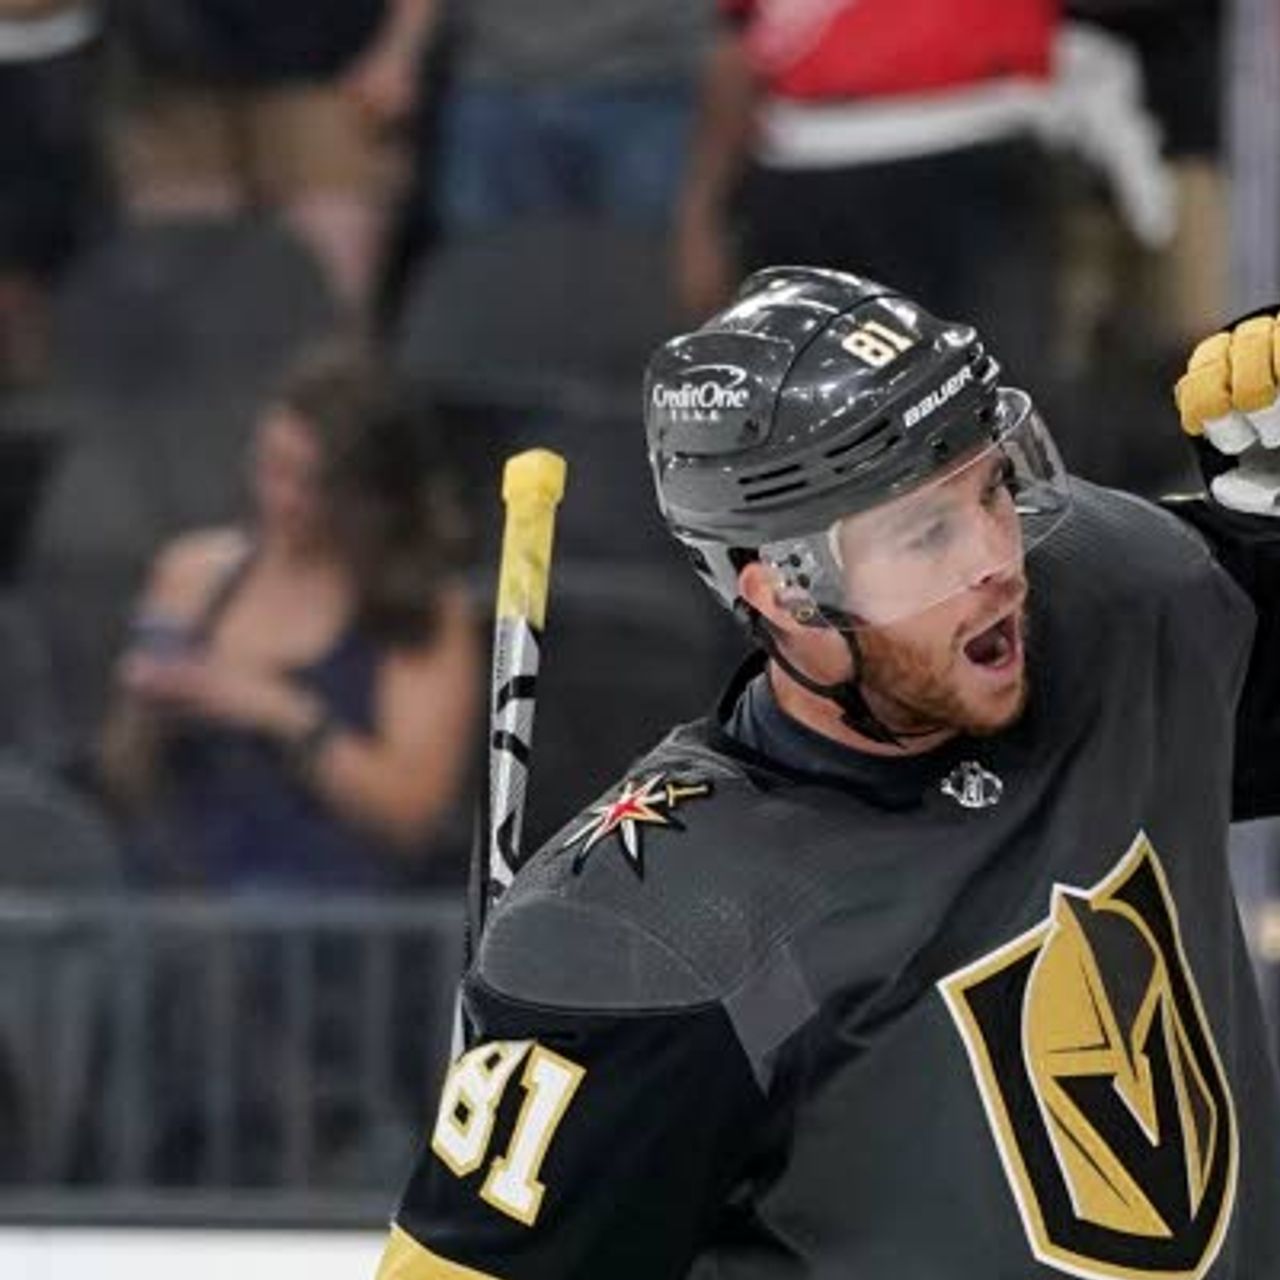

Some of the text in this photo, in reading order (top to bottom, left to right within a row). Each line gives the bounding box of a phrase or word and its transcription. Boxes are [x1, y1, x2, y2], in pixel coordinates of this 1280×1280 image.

[841, 320, 914, 368] 81
[902, 364, 974, 428] BAUER
[432, 1037, 588, 1227] 81
